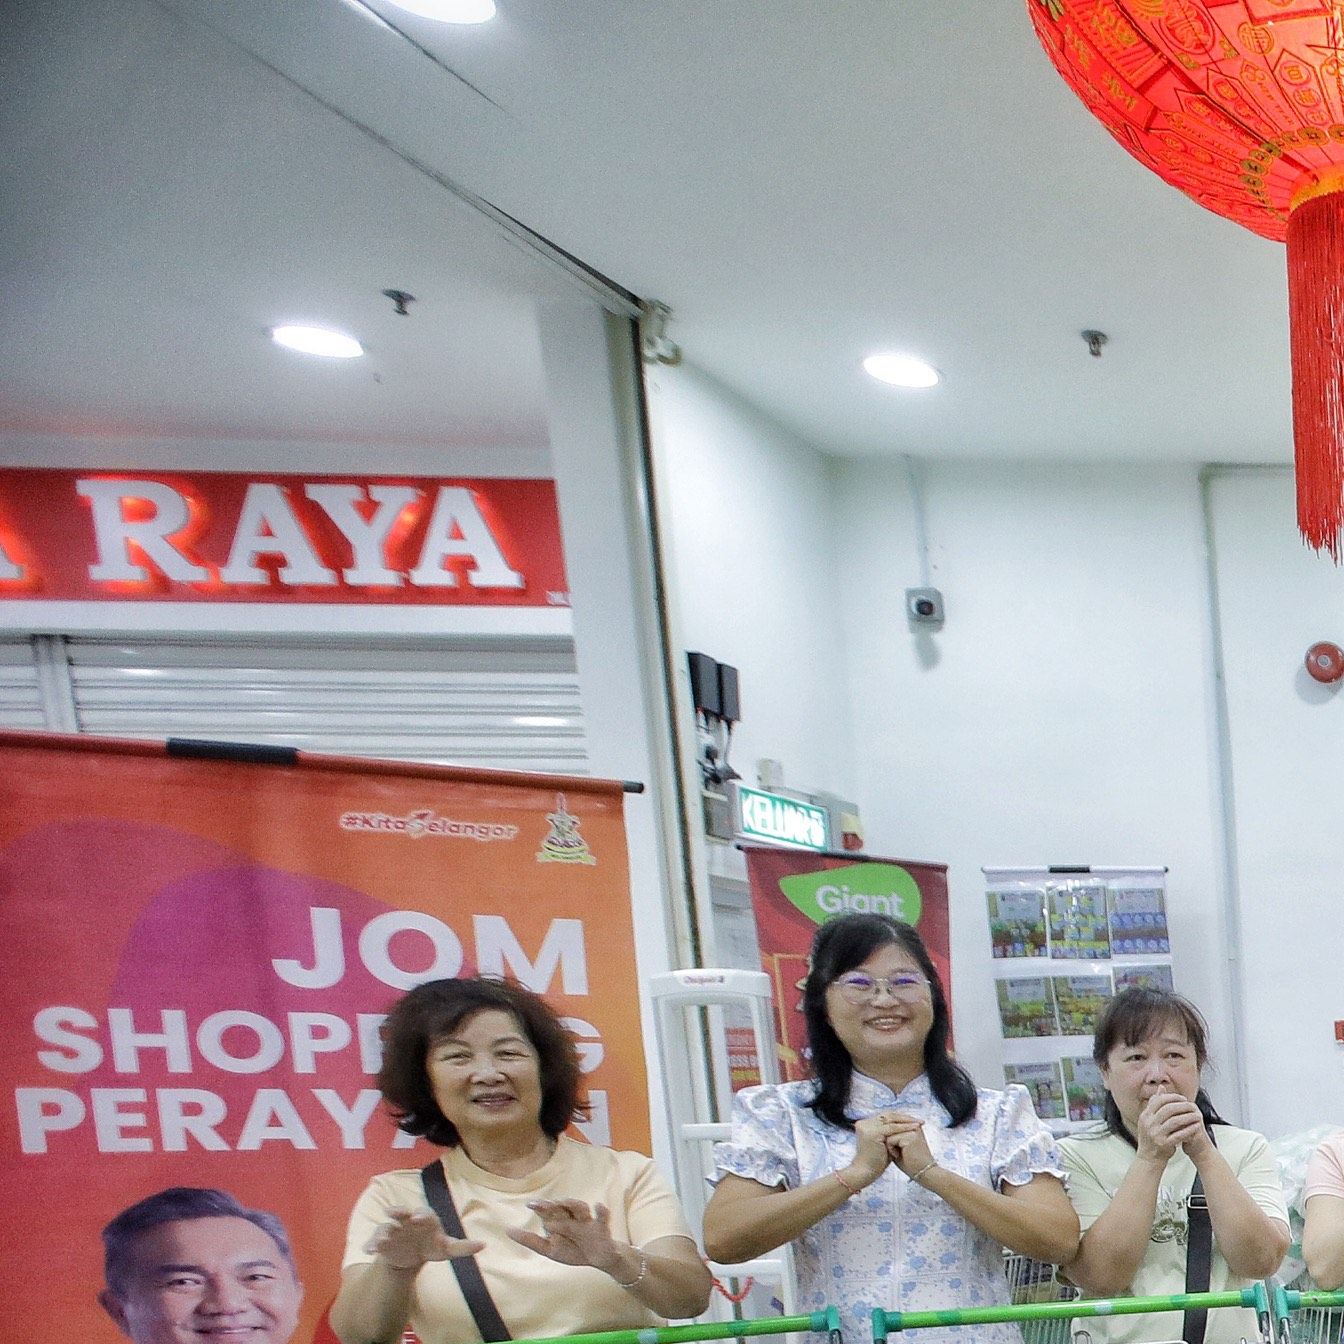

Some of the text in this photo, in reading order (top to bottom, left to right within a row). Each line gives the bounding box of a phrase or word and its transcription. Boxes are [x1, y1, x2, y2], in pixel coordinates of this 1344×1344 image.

[77, 478, 524, 588] RAYA
[816, 885, 905, 917] Giant
[272, 906, 589, 996] JOM
[34, 1005, 605, 1075] SHOPPG
[15, 1087, 611, 1154] PERAYN
